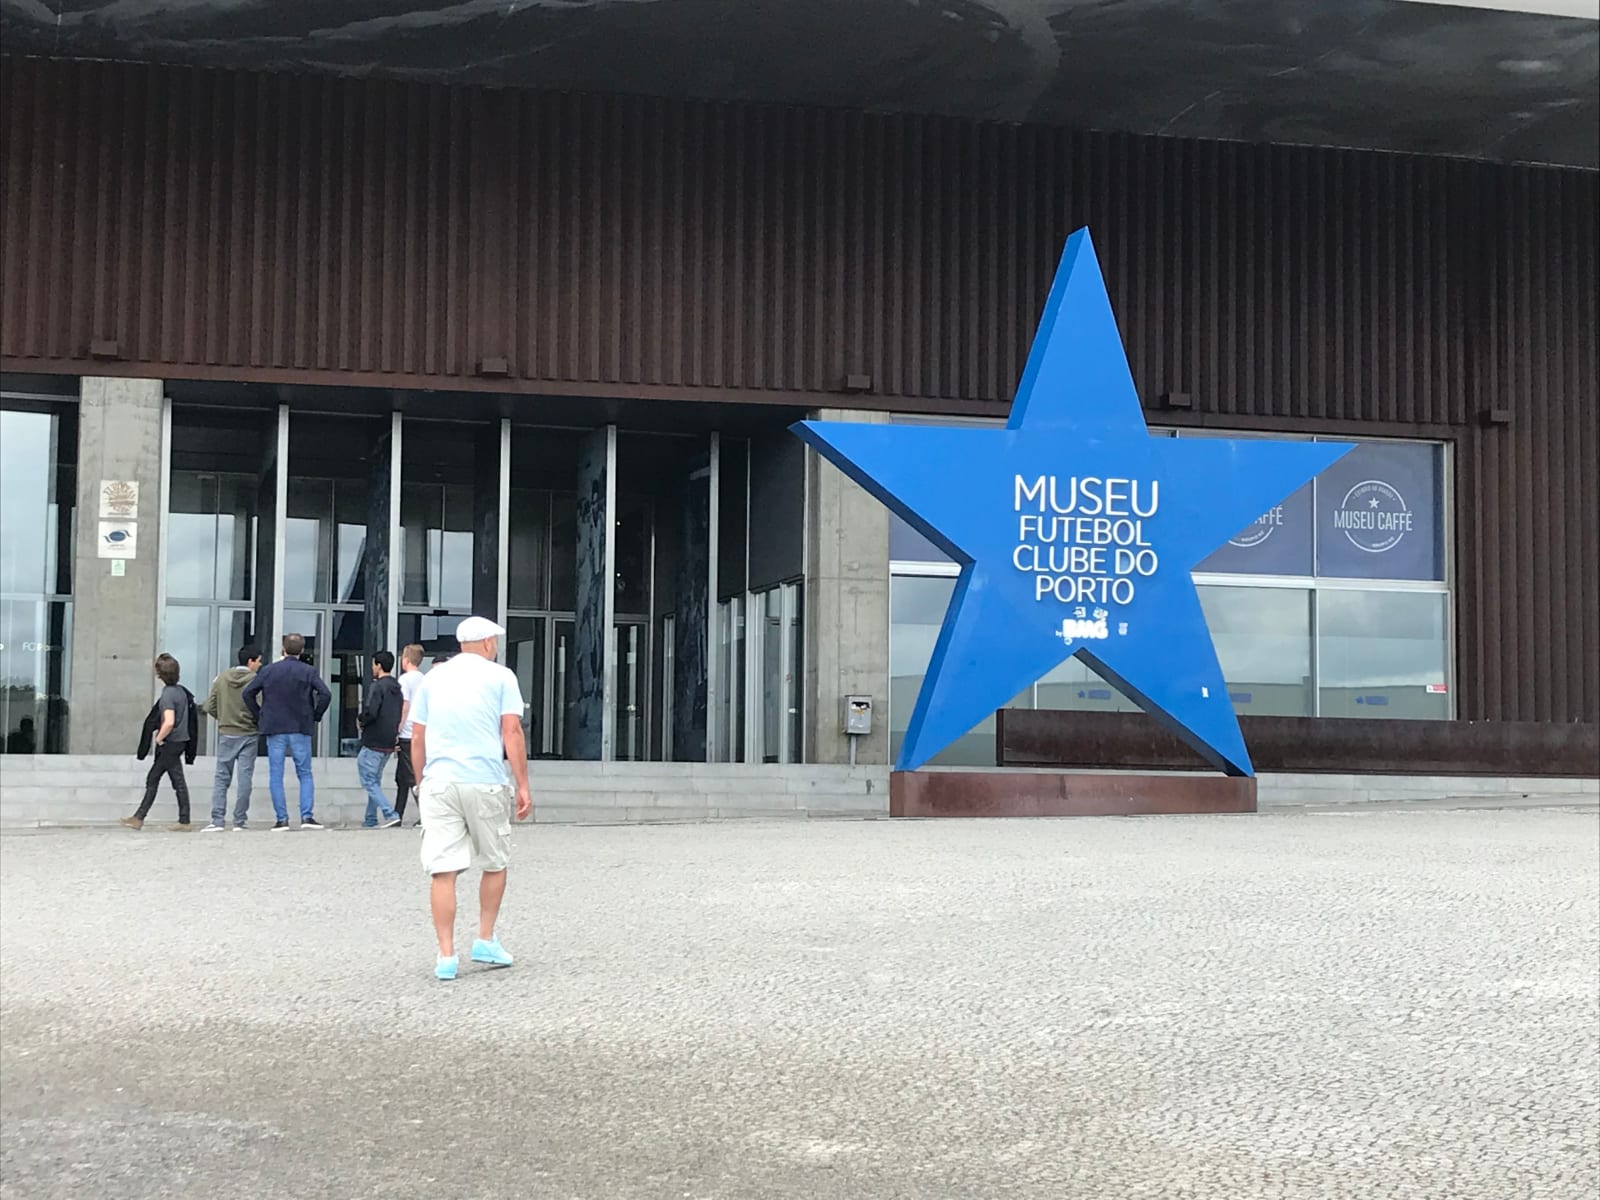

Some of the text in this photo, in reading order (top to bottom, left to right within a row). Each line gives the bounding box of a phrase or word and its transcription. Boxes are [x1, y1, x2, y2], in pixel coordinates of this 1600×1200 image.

[1014, 474, 1159, 517] MUSEU
[1019, 515, 1152, 546] FUTEBOL
[1334, 510, 1413, 532] MUSEU CAFFÉ
[1012, 544, 1158, 576] CLUBE DO
[1035, 575, 1134, 605] PORTO
